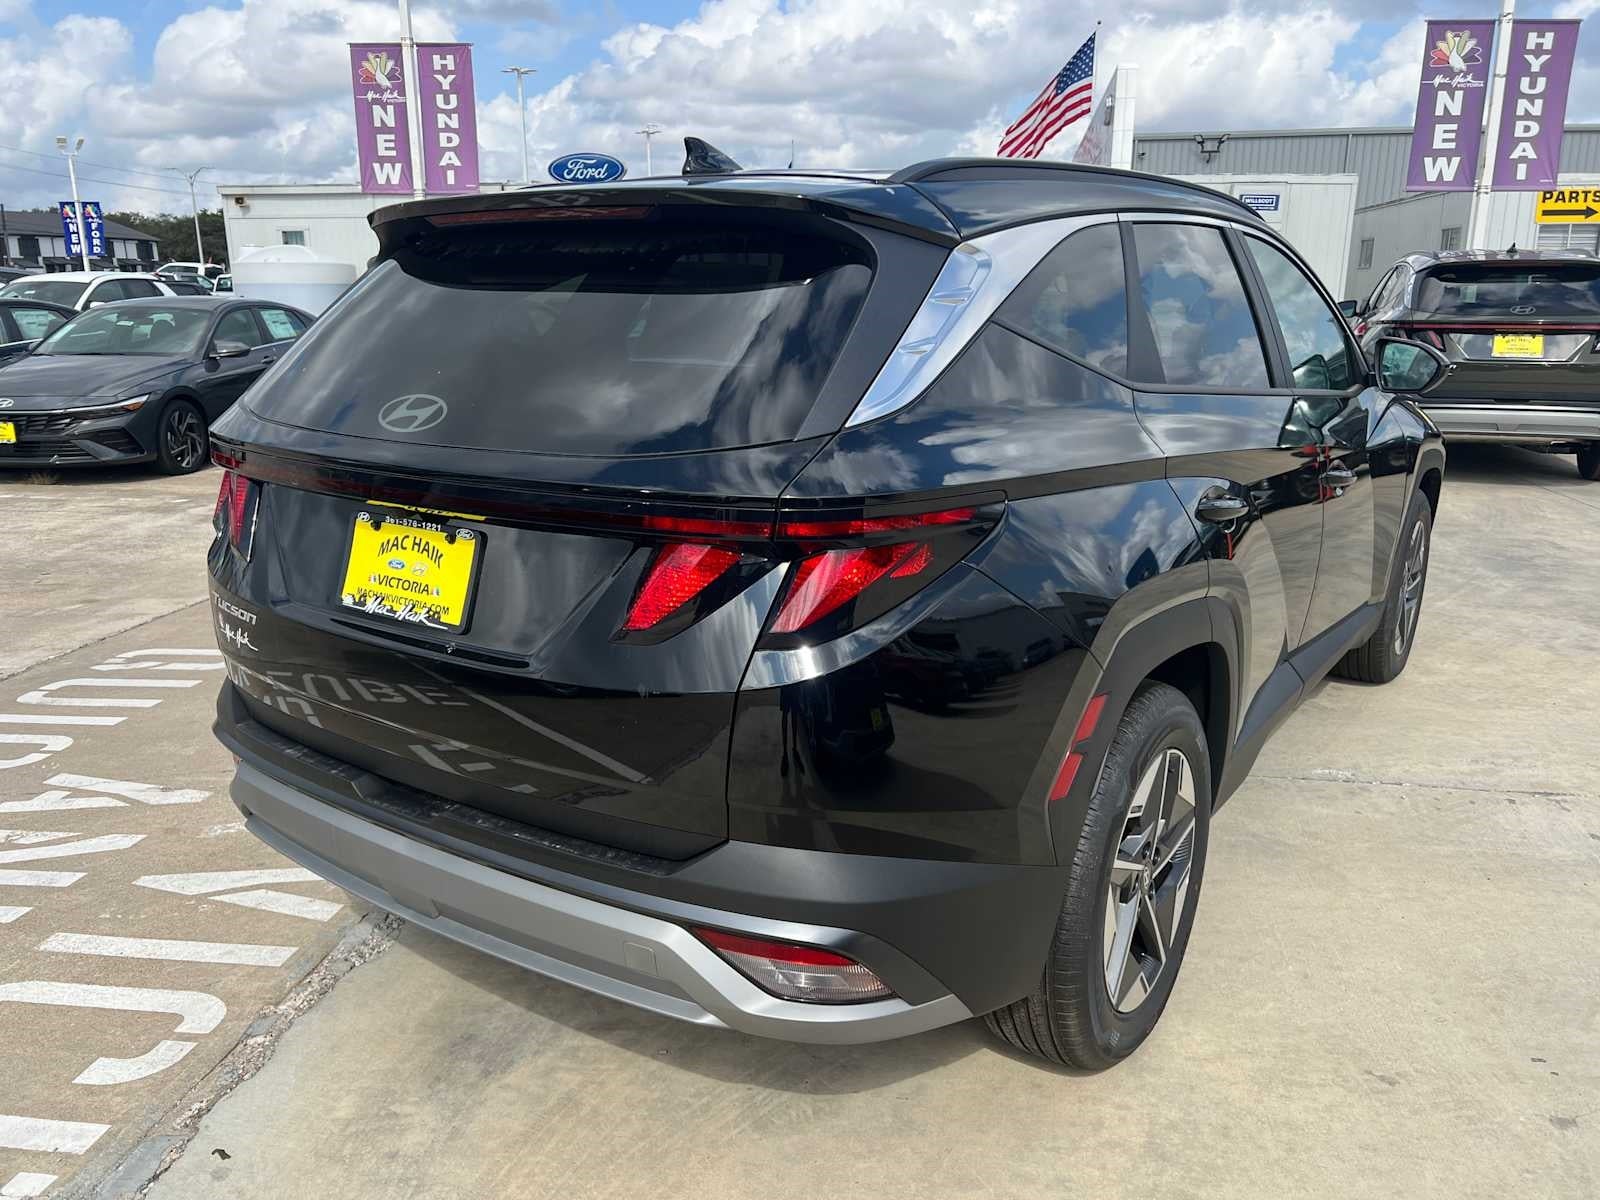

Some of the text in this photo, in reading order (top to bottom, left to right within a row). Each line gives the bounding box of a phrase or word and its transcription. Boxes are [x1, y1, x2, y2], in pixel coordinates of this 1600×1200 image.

[432, 54, 462, 185] HYUNDAI
[1509, 31, 1555, 181] HYUNDAI
[372, 104, 402, 185] NEW
[1424, 90, 1464, 183] NEW
[563, 158, 608, 179] Ford
[1541, 190, 1600, 203] PARTS
[69, 223, 80, 253] NEW
[91, 222, 101, 253] FORD
[377, 534, 444, 568] MAC HAIK
[377, 573, 430, 595] VICTORIA
[363, 597, 395, 617] Mac
